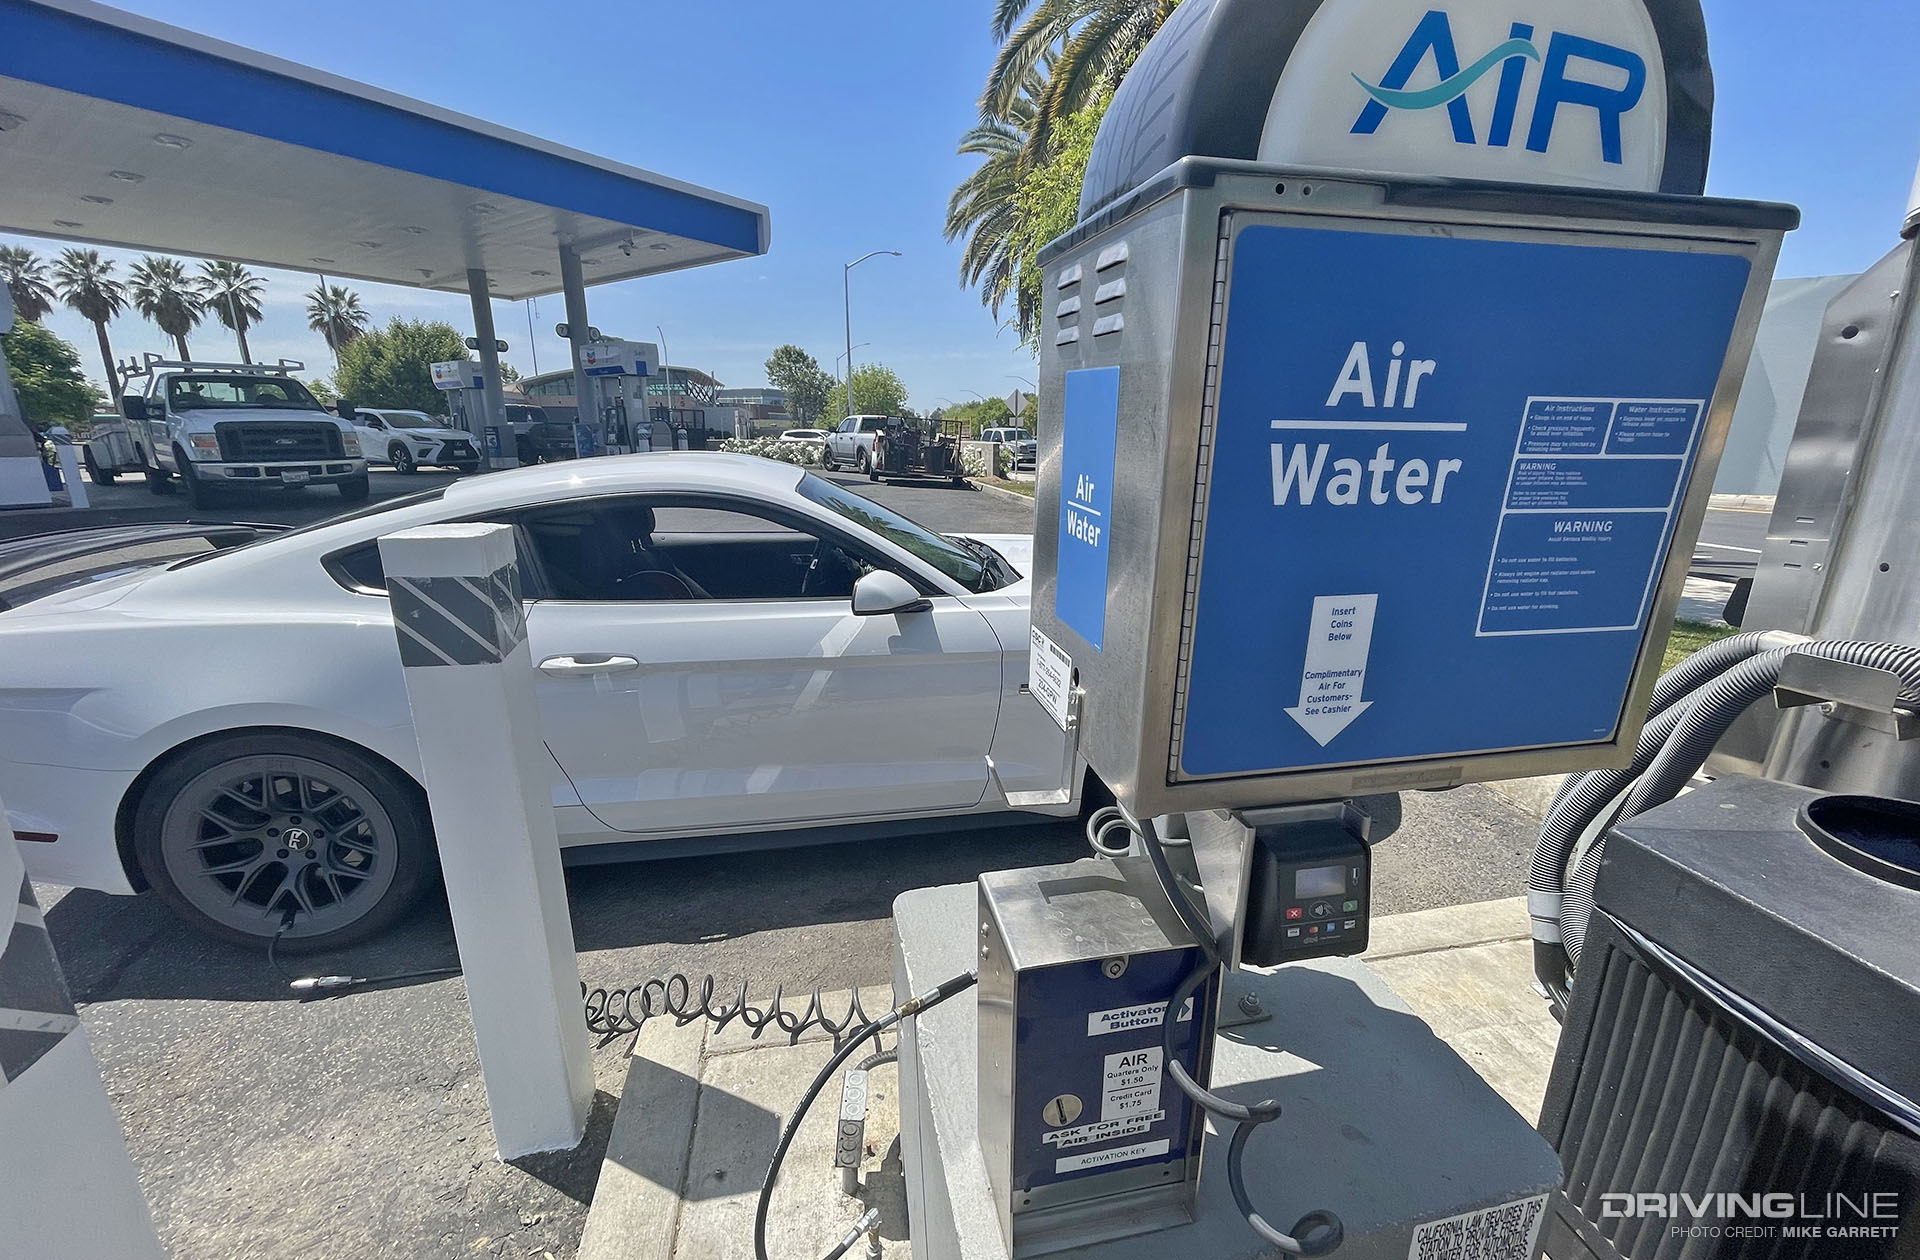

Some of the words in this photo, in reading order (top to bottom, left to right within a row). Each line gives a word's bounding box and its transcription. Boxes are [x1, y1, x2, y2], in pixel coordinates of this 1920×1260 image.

[1325, 340, 1437, 409] Air
[1270, 442, 1463, 506] Water
[1075, 474, 1095, 504] Air
[1066, 509, 1102, 548] Water
[1554, 521, 1613, 532] WARNING
[1331, 606, 1357, 616] Insert
[1330, 620, 1353, 629] Coins
[1328, 633, 1352, 641] Below
[1304, 669, 1363, 680] Complimentary
[1318, 683, 1331, 691] Air
[1332, 682, 1346, 690] For
[1305, 707, 1320, 716] See
[1321, 705, 1352, 715] Cashier
[1110, 1017, 1158, 1030] Button
[1119, 1053, 1148, 1069] AIR
[1107, 1069, 1139, 1079] Quarters
[1141, 1065, 1159, 1073] Only
[1121, 1076, 1144, 1086] $1.50
[1110, 1093, 1133, 1102] Credit
[1134, 1089, 1153, 1098] Card
[1119, 1100, 1142, 1110] $1.75
[1049, 1128, 1081, 1141] ASK
[1088, 1121, 1120, 1133] FOR
[1126, 1112, 1162, 1125] FREE
[1061, 1136, 1089, 1147] AIR
[1095, 1125, 1146, 1140] INSIDE
[1080, 1150, 1129, 1165] ACTIVATION
[1130, 1147, 1148, 1157] KEY
[1418, 1219, 1463, 1243] CALIFORNIA
[1465, 1214, 1485, 1232] LAW
[1485, 1203, 1524, 1226] REQUIRES
[1525, 1198, 1543, 1218] THIS
[1419, 1236, 1451, 1257] STATION
[1454, 1231, 1464, 1249] TO
[1466, 1222, 1499, 1246] PROVIDE
[1499, 1217, 1520, 1238] FREE
[1520, 1213, 1535, 1231] AIR
[1464, 1241, 1481, 1260] FOR
